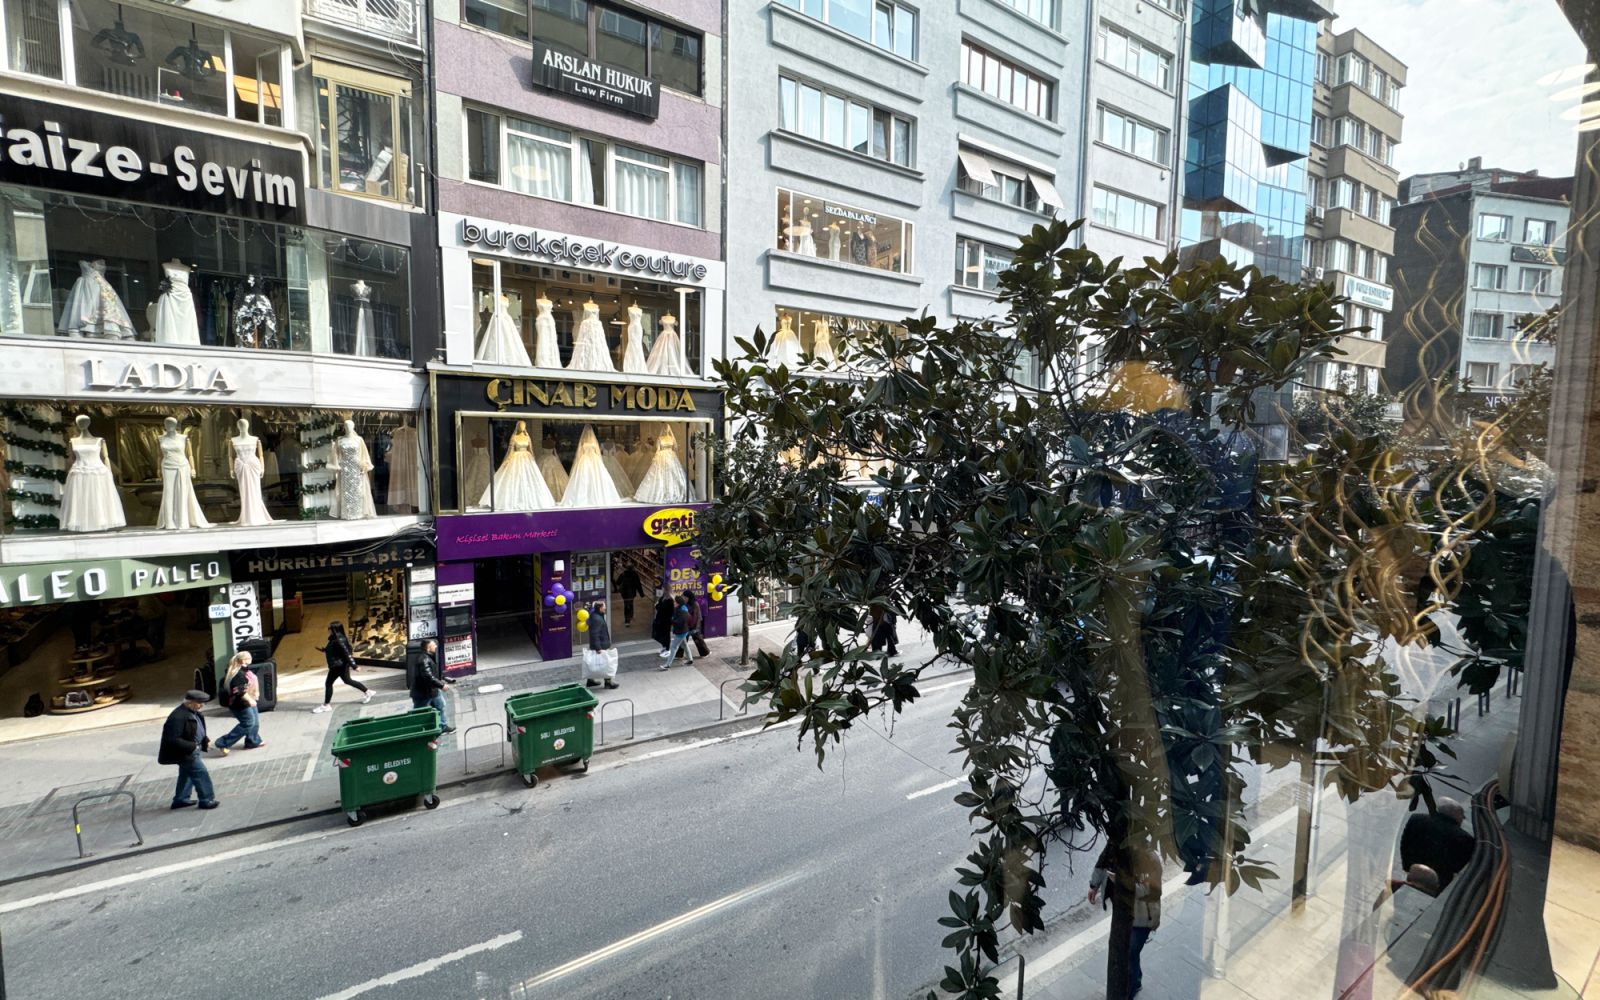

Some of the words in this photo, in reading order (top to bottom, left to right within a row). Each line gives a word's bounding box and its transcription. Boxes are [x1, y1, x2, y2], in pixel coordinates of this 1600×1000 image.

[542, 49, 602, 81] ARSLAN
[605, 67, 653, 97] HUKUK
[575, 82, 597, 96] Law
[599, 89, 623, 104] Firm
[0, 113, 297, 208] aize-Sevim
[617, 251, 708, 280] couture
[610, 385, 697, 411] MODA
[650, 511, 697, 536] grati
[135, 561, 219, 587] PALEO
